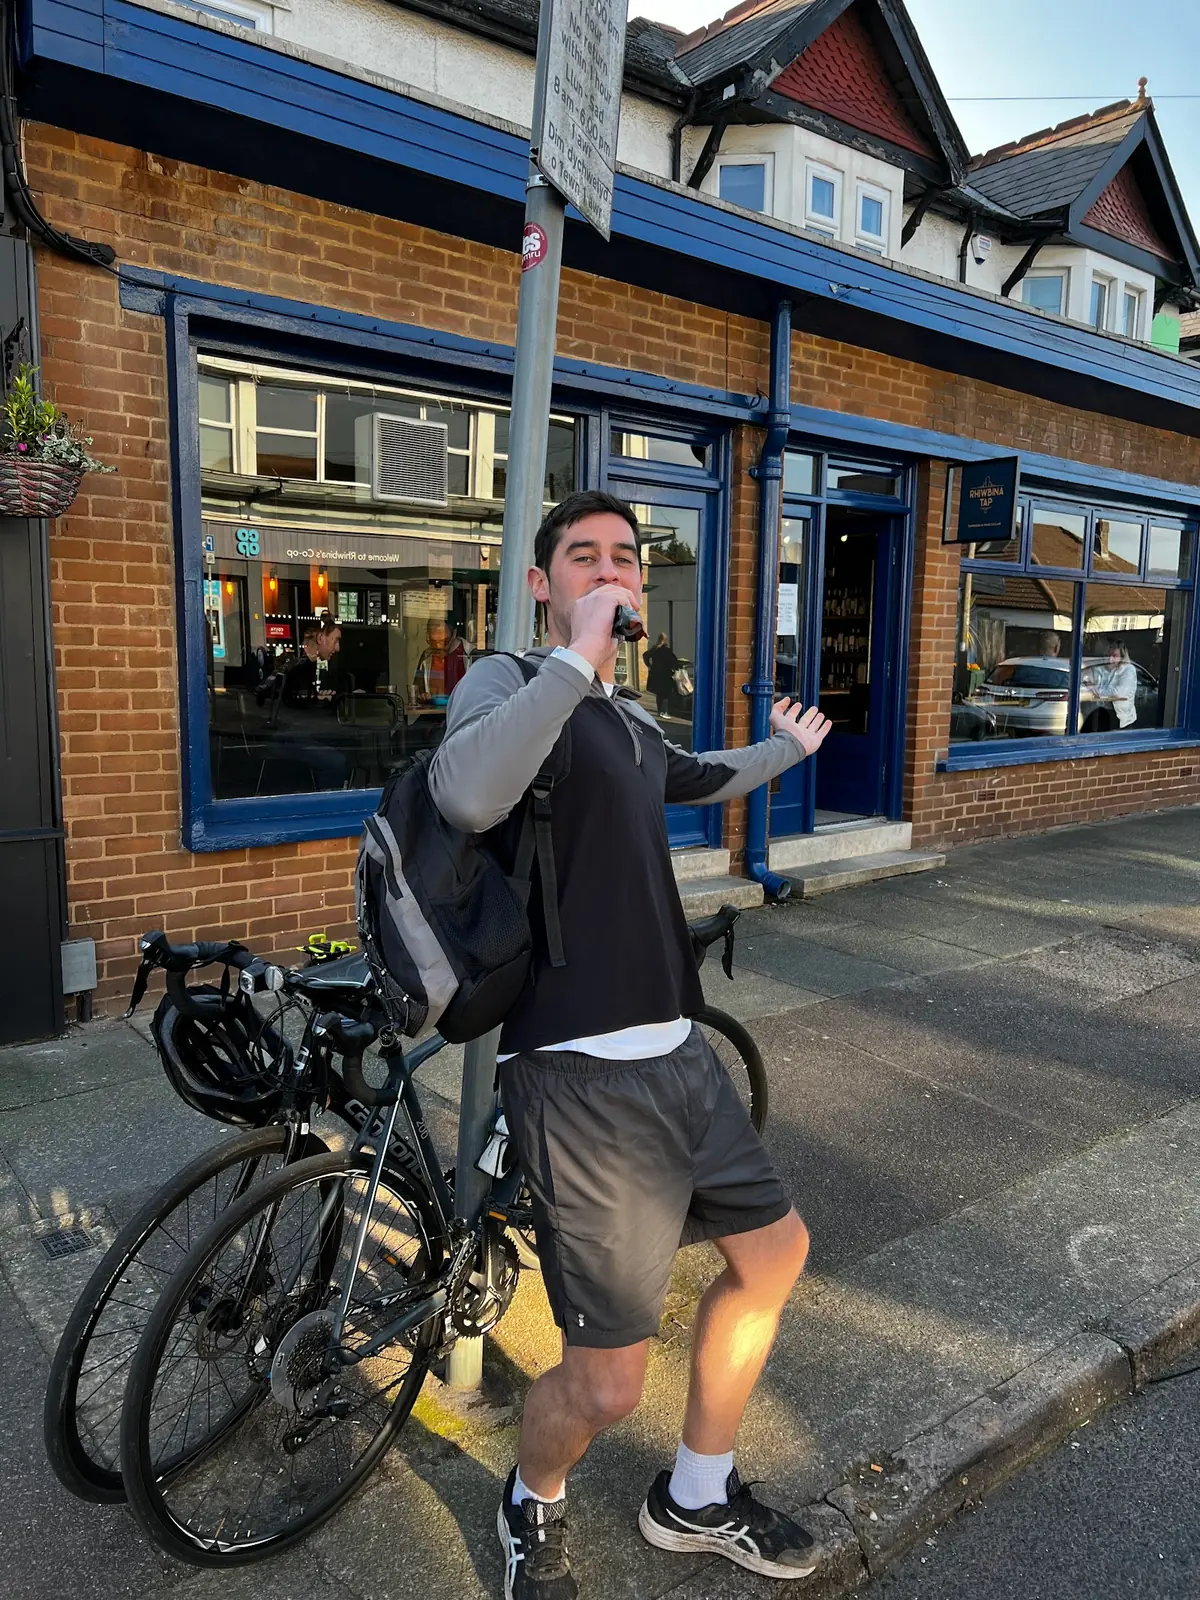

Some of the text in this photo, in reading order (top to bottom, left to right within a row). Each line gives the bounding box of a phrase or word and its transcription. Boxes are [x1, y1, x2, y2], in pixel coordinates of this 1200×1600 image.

[570, 11, 608, 76] No return
[585, 7, 602, 43] hour
[608, 19, 620, 44] pm
[561, 30, 587, 73] within
[595, 71, 611, 104] hour
[554, 75, 560, 95] 8
[561, 88, 574, 113] am
[580, 107, 598, 141] 6.00
[598, 135, 611, 157] pm
[565, 62, 583, 98] Llun
[588, 94, 605, 124] Sad
[548, 121, 609, 202] Dim dychwelyd
[577, 134, 592, 158] awr
[551, 156, 557, 170] o
[560, 160, 580, 196] fewn
[588, 198, 602, 219] awr
[522, 251, 541, 261] mru
[969, 487, 1004, 499] RHIWBINA
[979, 498, 993, 507] TAP
